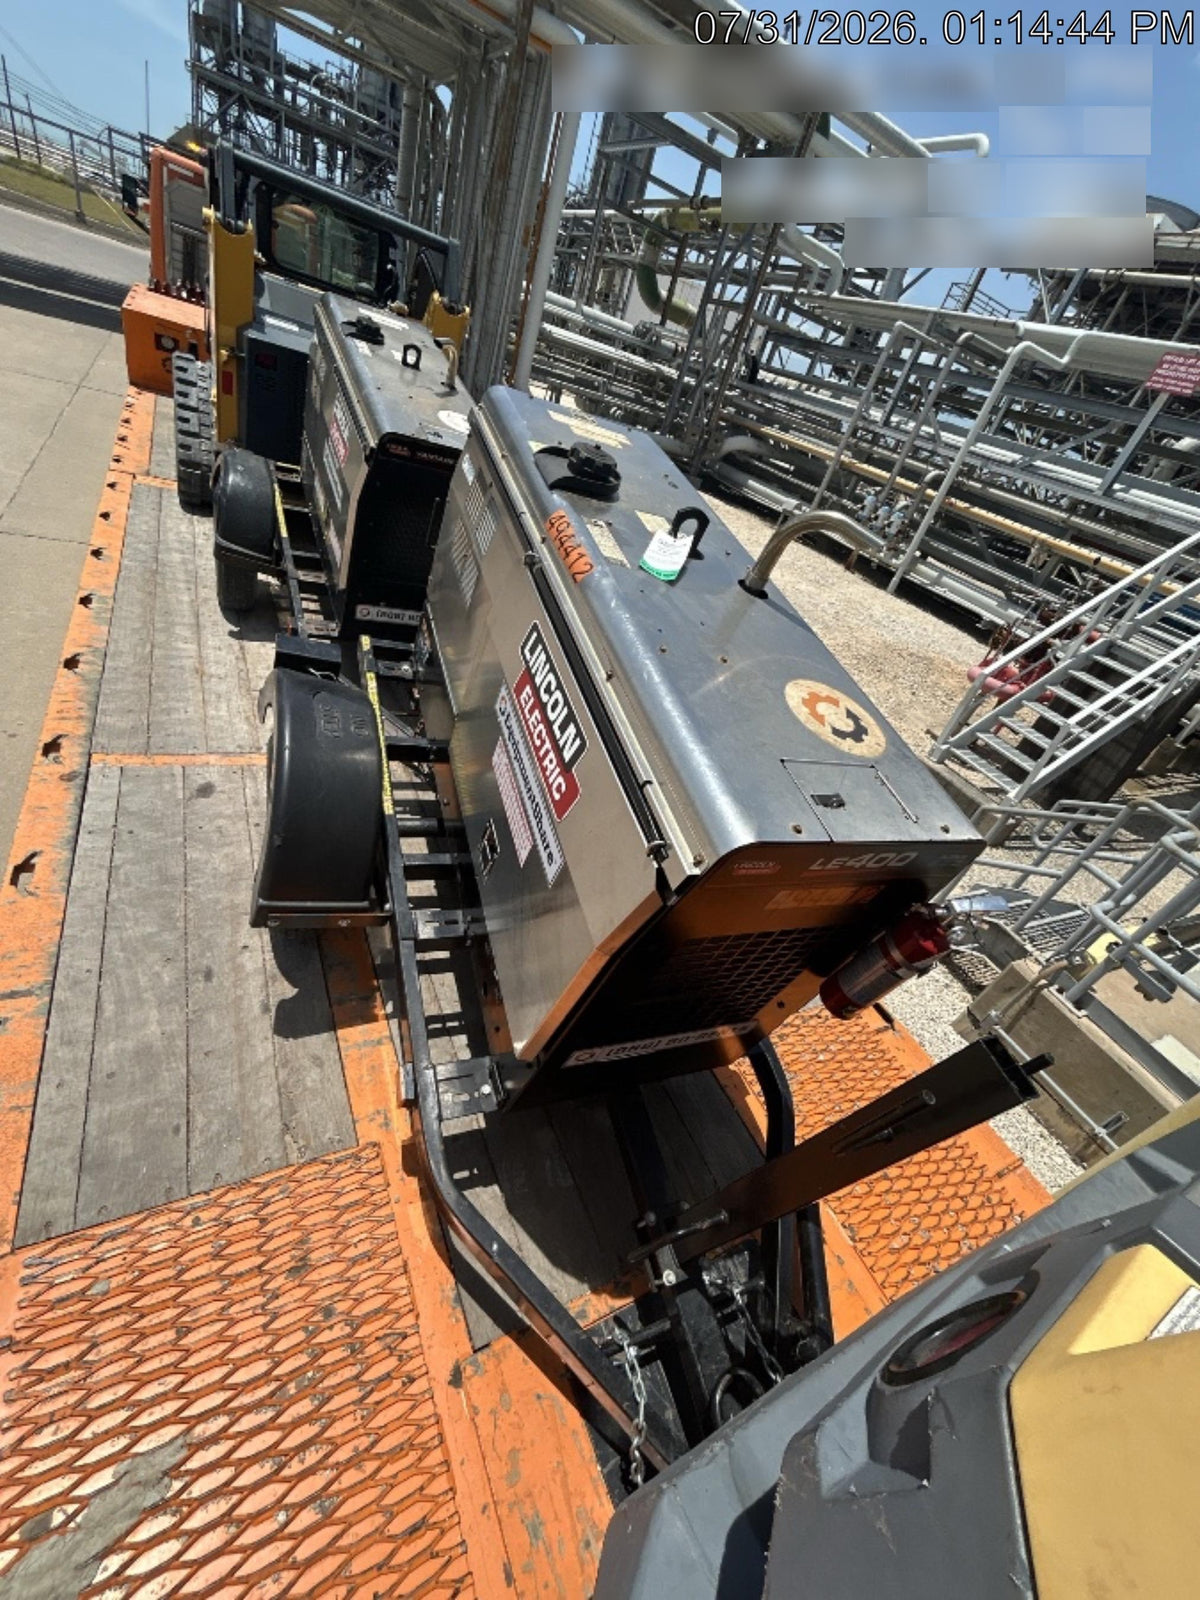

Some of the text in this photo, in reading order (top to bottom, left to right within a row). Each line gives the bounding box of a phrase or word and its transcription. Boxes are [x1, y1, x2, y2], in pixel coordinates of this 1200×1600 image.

[548, 514, 594, 583] 494412
[519, 684, 566, 801] ELECTRIC
[524, 630, 582, 763] LINCOLN
[808, 851, 919, 871] LE400
